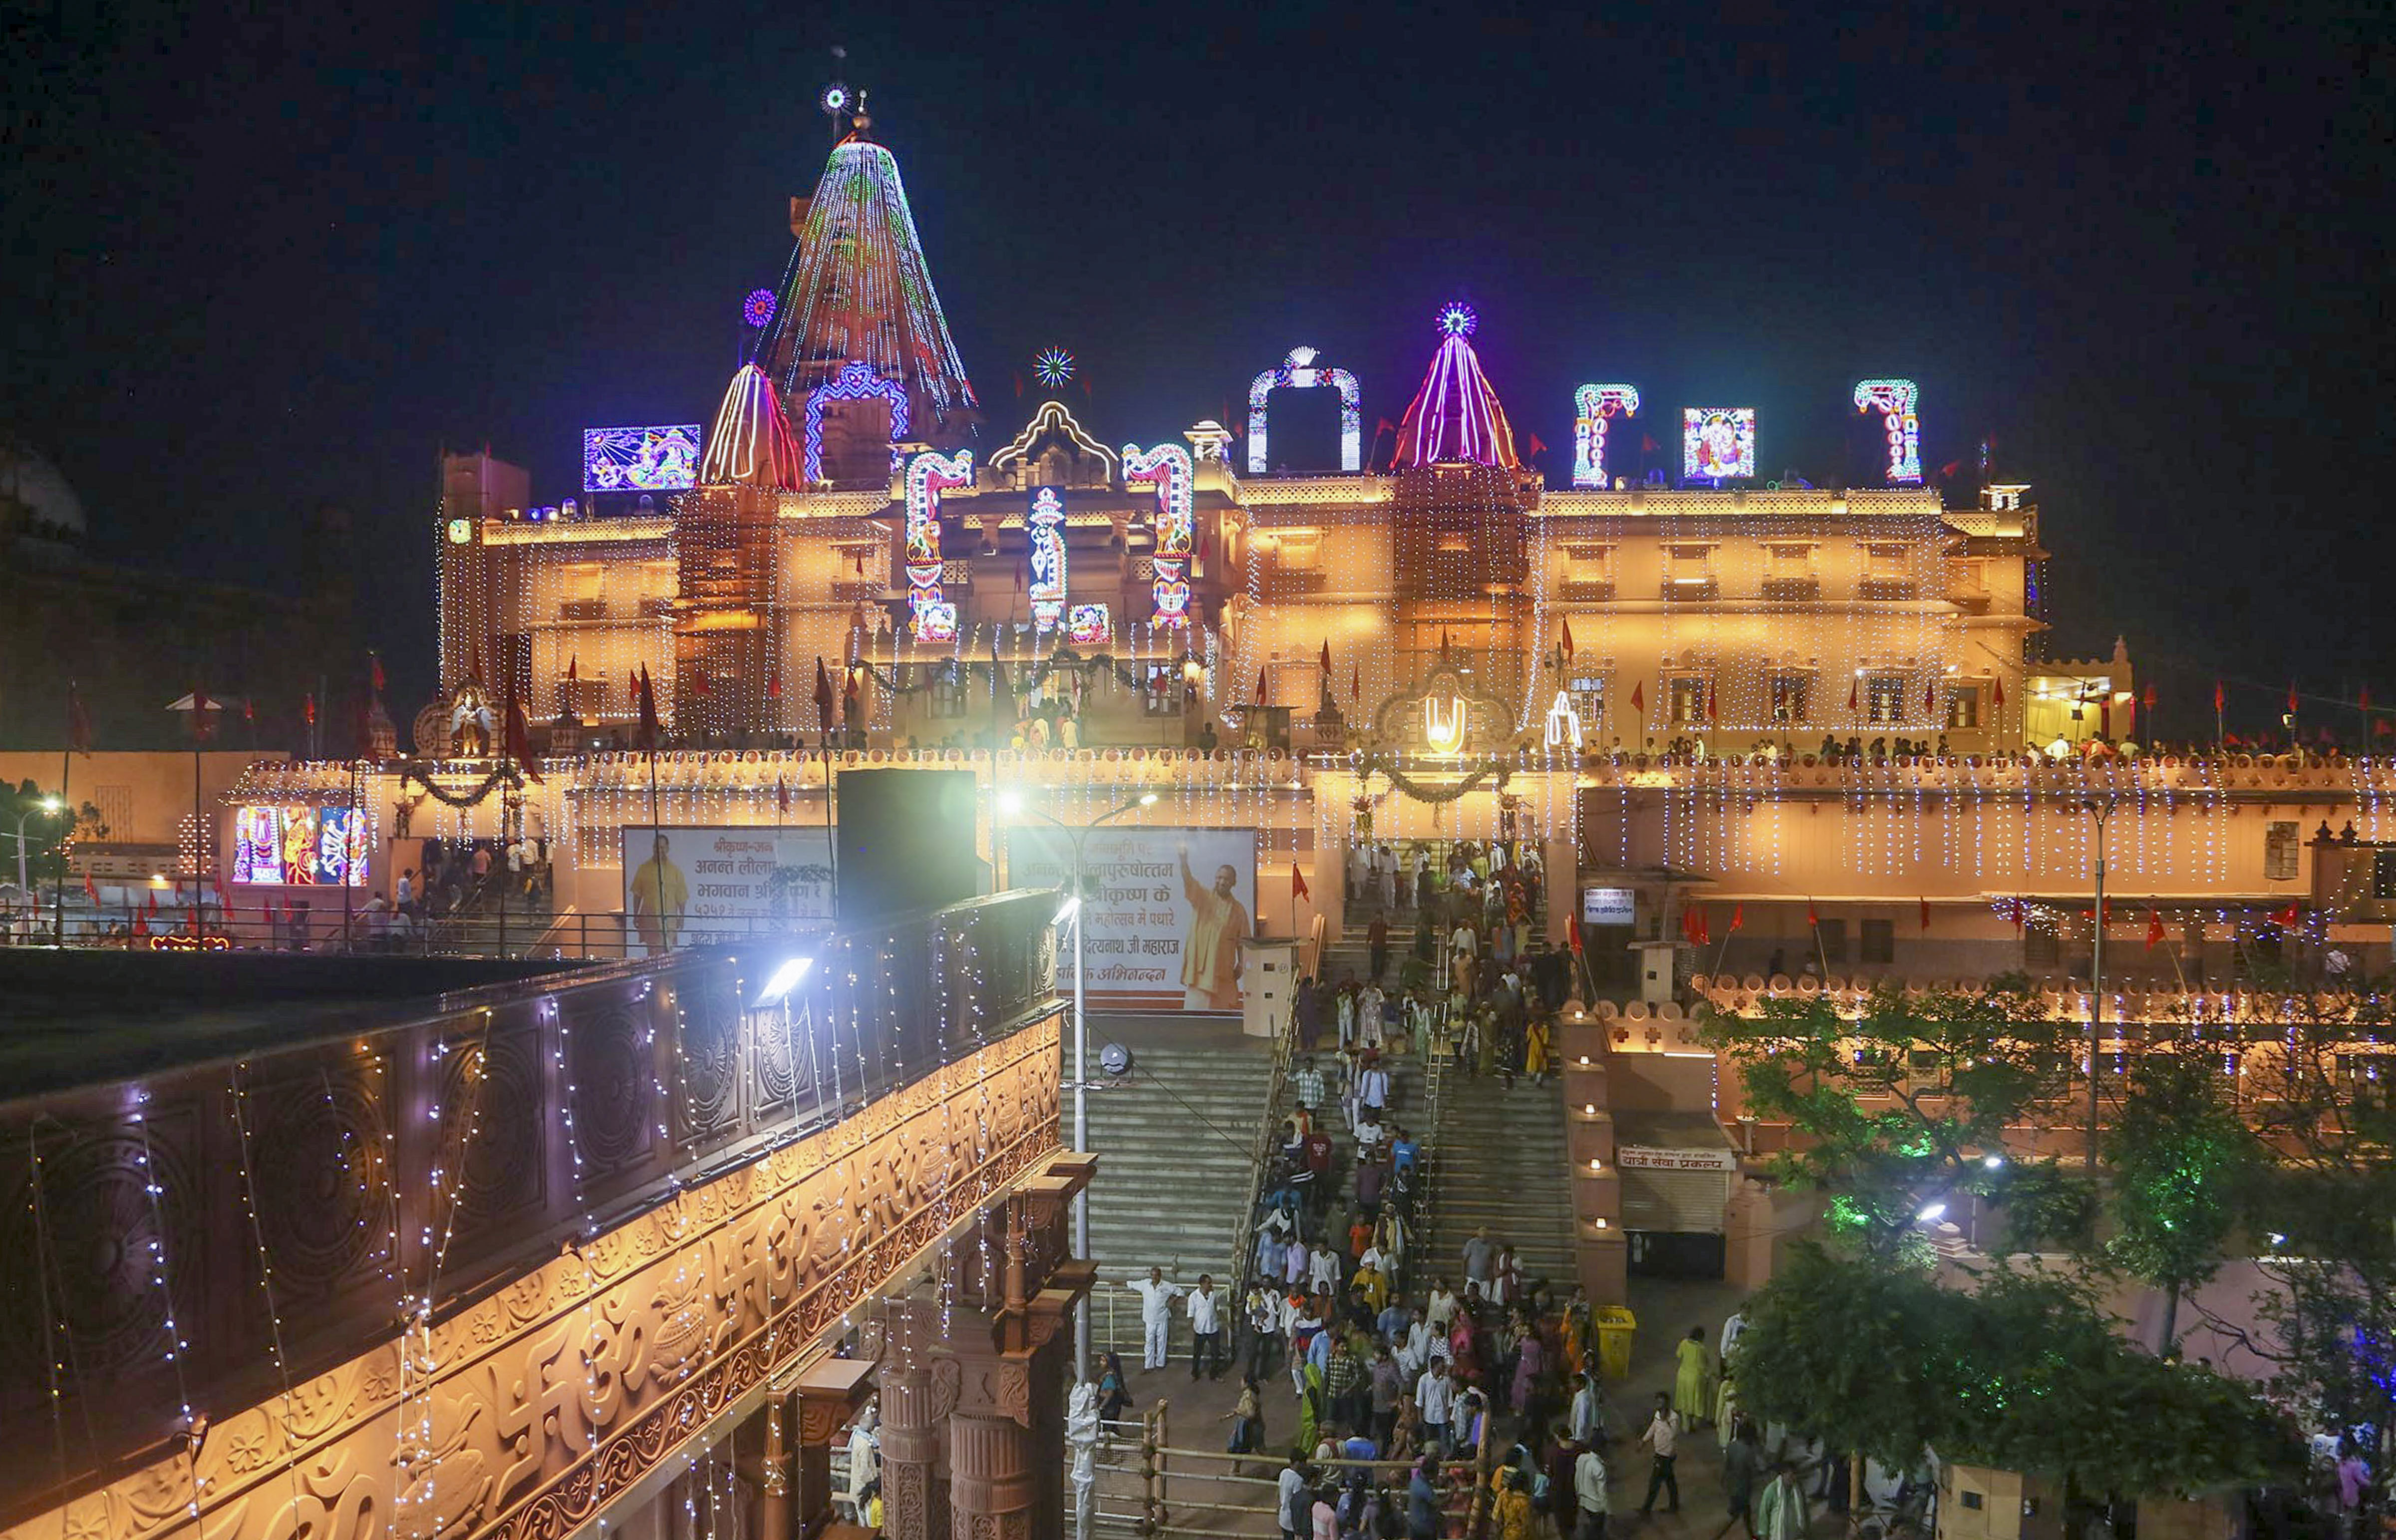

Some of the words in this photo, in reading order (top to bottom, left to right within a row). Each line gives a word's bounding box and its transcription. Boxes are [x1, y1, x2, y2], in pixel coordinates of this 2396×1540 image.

[695, 860, 734, 875] अनन्त
[738, 857, 777, 875] लीला
[697, 883, 749, 898] भगवान
[1152, 883, 1172, 902] के
[1094, 907, 1134, 928] महोत्सव
[1149, 907, 1175, 926] पधारे
[1127, 934, 1138, 954] जी
[1141, 939, 1179, 955] महाराज
[1097, 963, 1166, 982] अभिनन्दन
[1623, 1156, 1648, 1165] यात्री
[1652, 1157, 1674, 1167] सेवा
[1679, 1160, 1723, 1169] प्रकल्प
